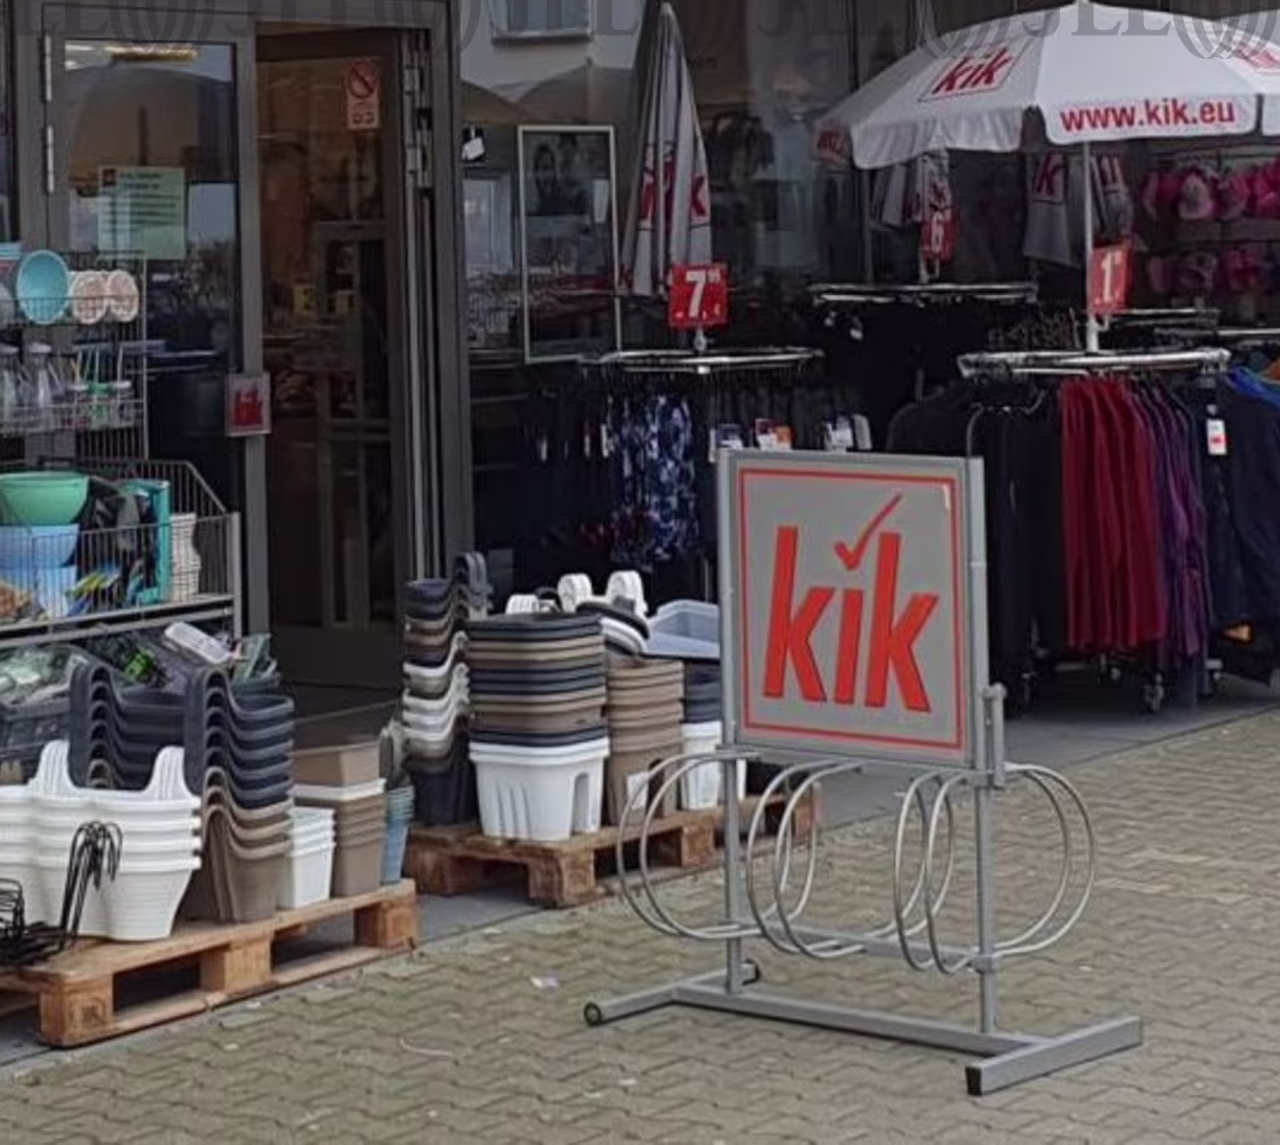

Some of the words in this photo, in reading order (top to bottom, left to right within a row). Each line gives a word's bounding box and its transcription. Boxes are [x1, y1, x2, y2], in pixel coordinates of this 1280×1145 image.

[932, 47, 1012, 95] kik
[1060, 98, 1236, 135] www.kik.eu
[762, 495, 939, 713] kik
